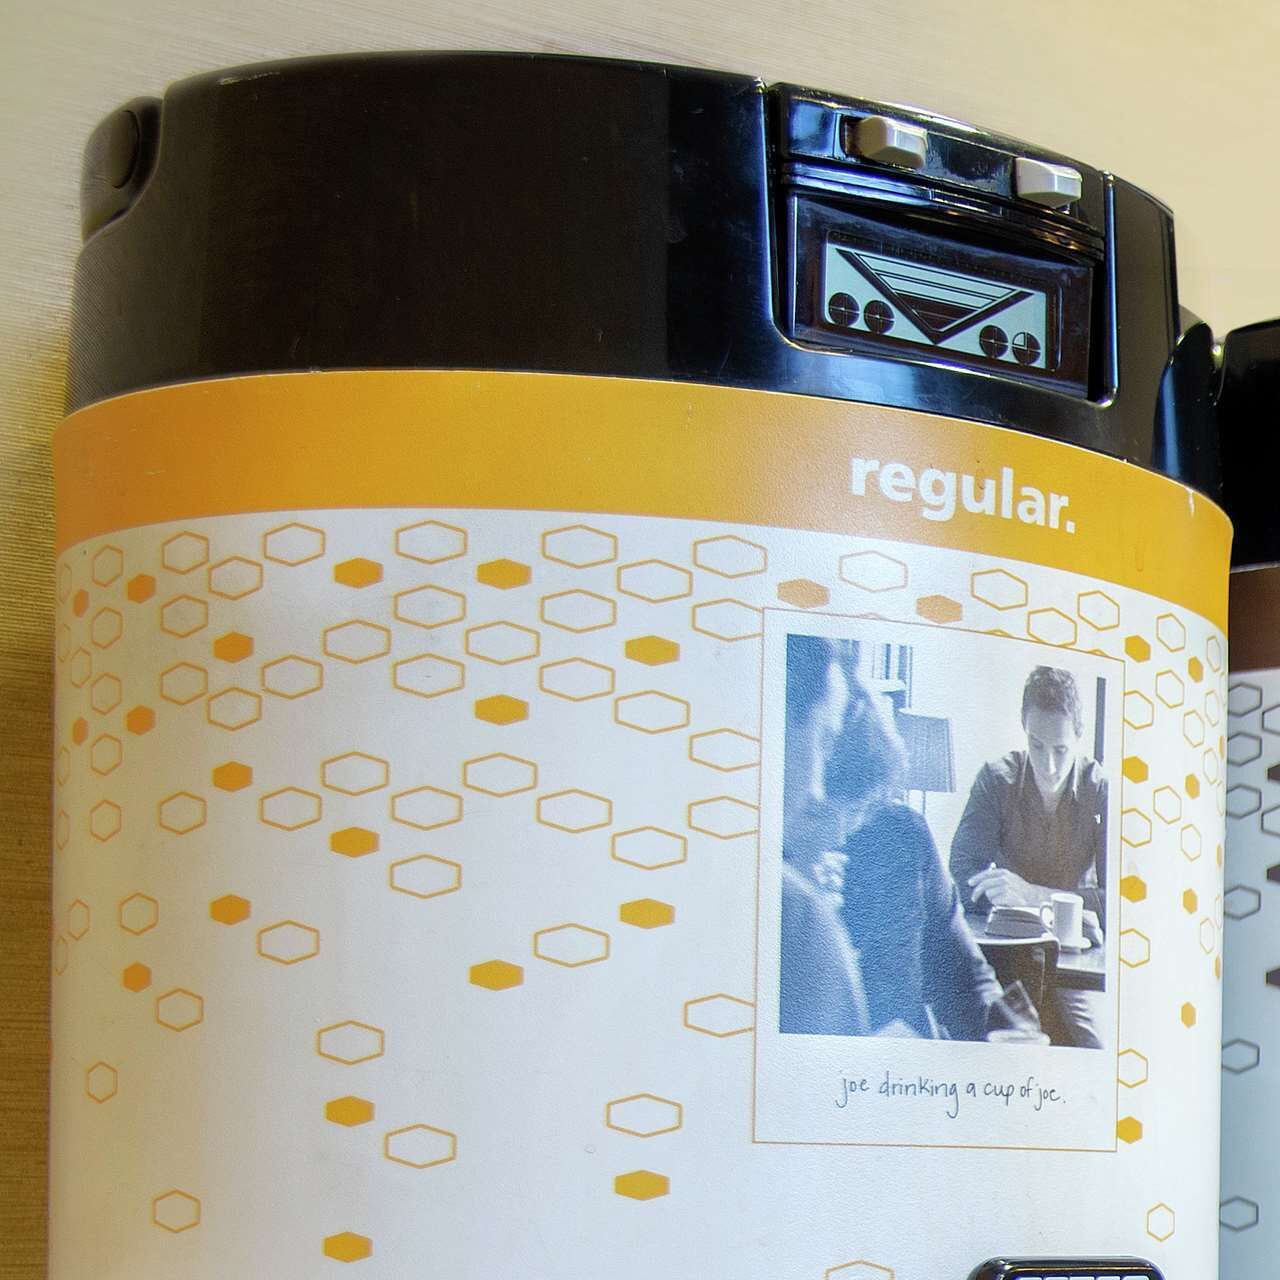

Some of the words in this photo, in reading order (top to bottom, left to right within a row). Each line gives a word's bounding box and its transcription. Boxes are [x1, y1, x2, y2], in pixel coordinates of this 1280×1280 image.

[850, 456, 1077, 534] regular.
[835, 1070, 870, 1109] joe
[878, 1070, 960, 1119] drinking
[966, 1082, 977, 1098] a
[984, 1081, 1015, 1107] cup
[1020, 1076, 1035, 1098] of
